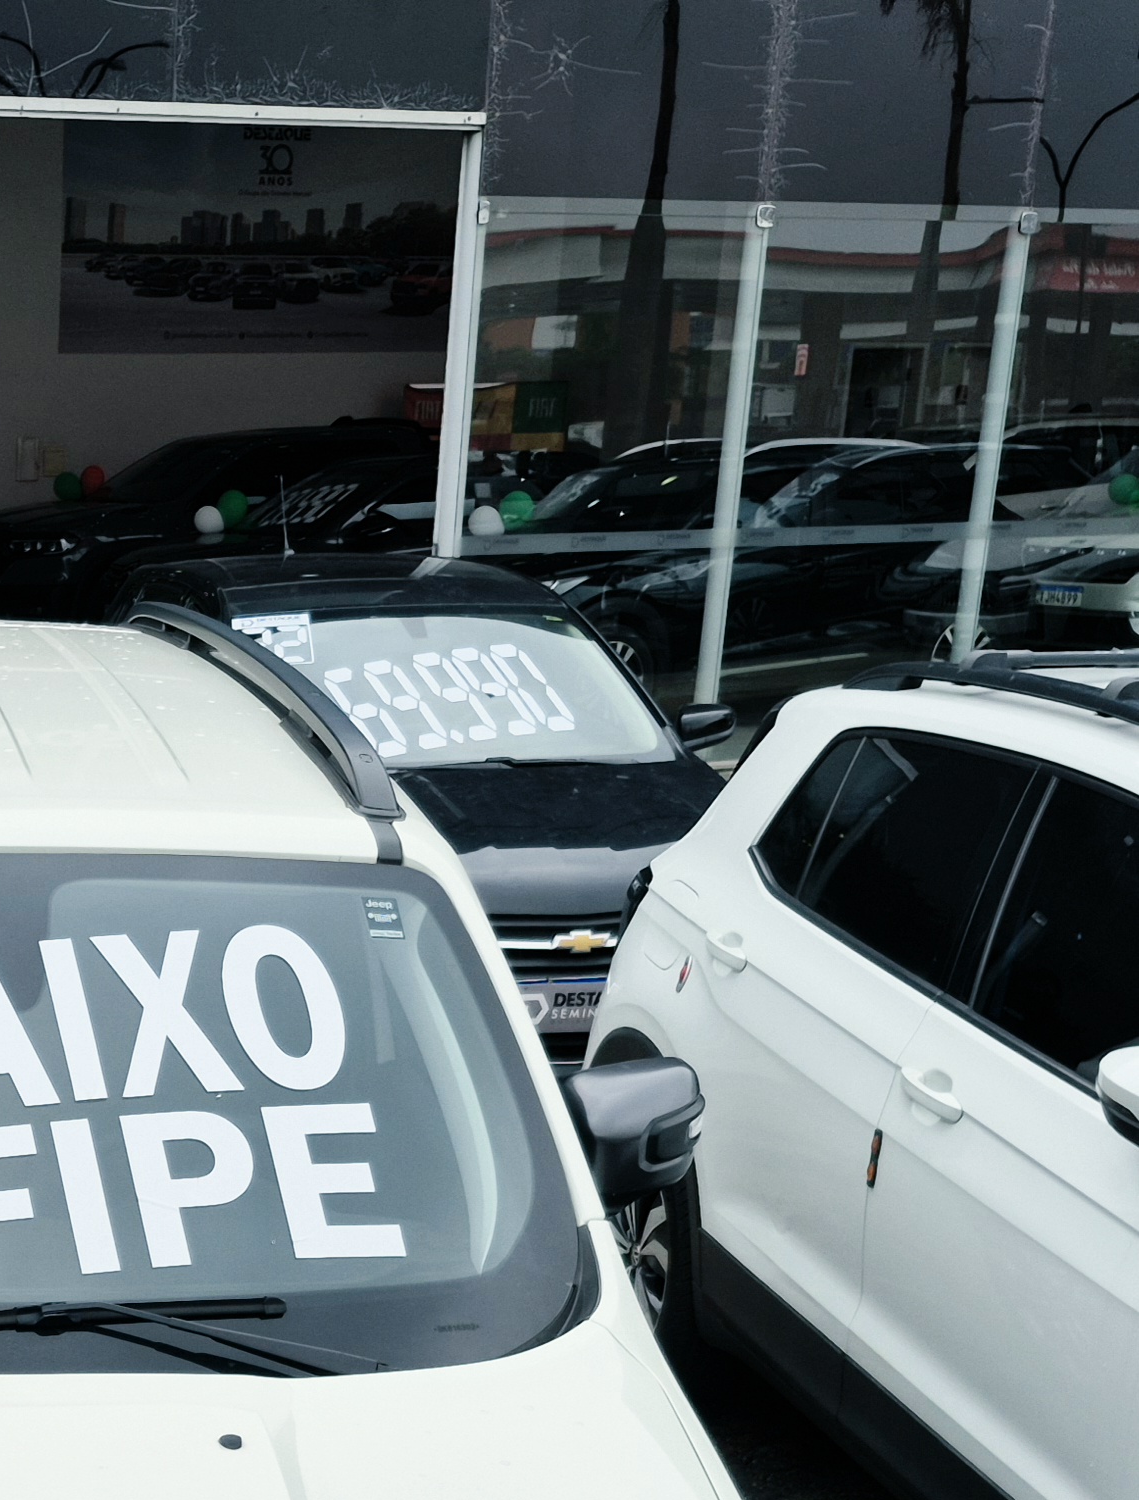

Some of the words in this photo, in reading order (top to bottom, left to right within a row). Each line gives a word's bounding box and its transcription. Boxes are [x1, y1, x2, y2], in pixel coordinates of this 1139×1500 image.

[258, 176, 293, 187] ANOS
[528, 397, 557, 418] FIAT
[365, 898, 394, 911] Jeep
